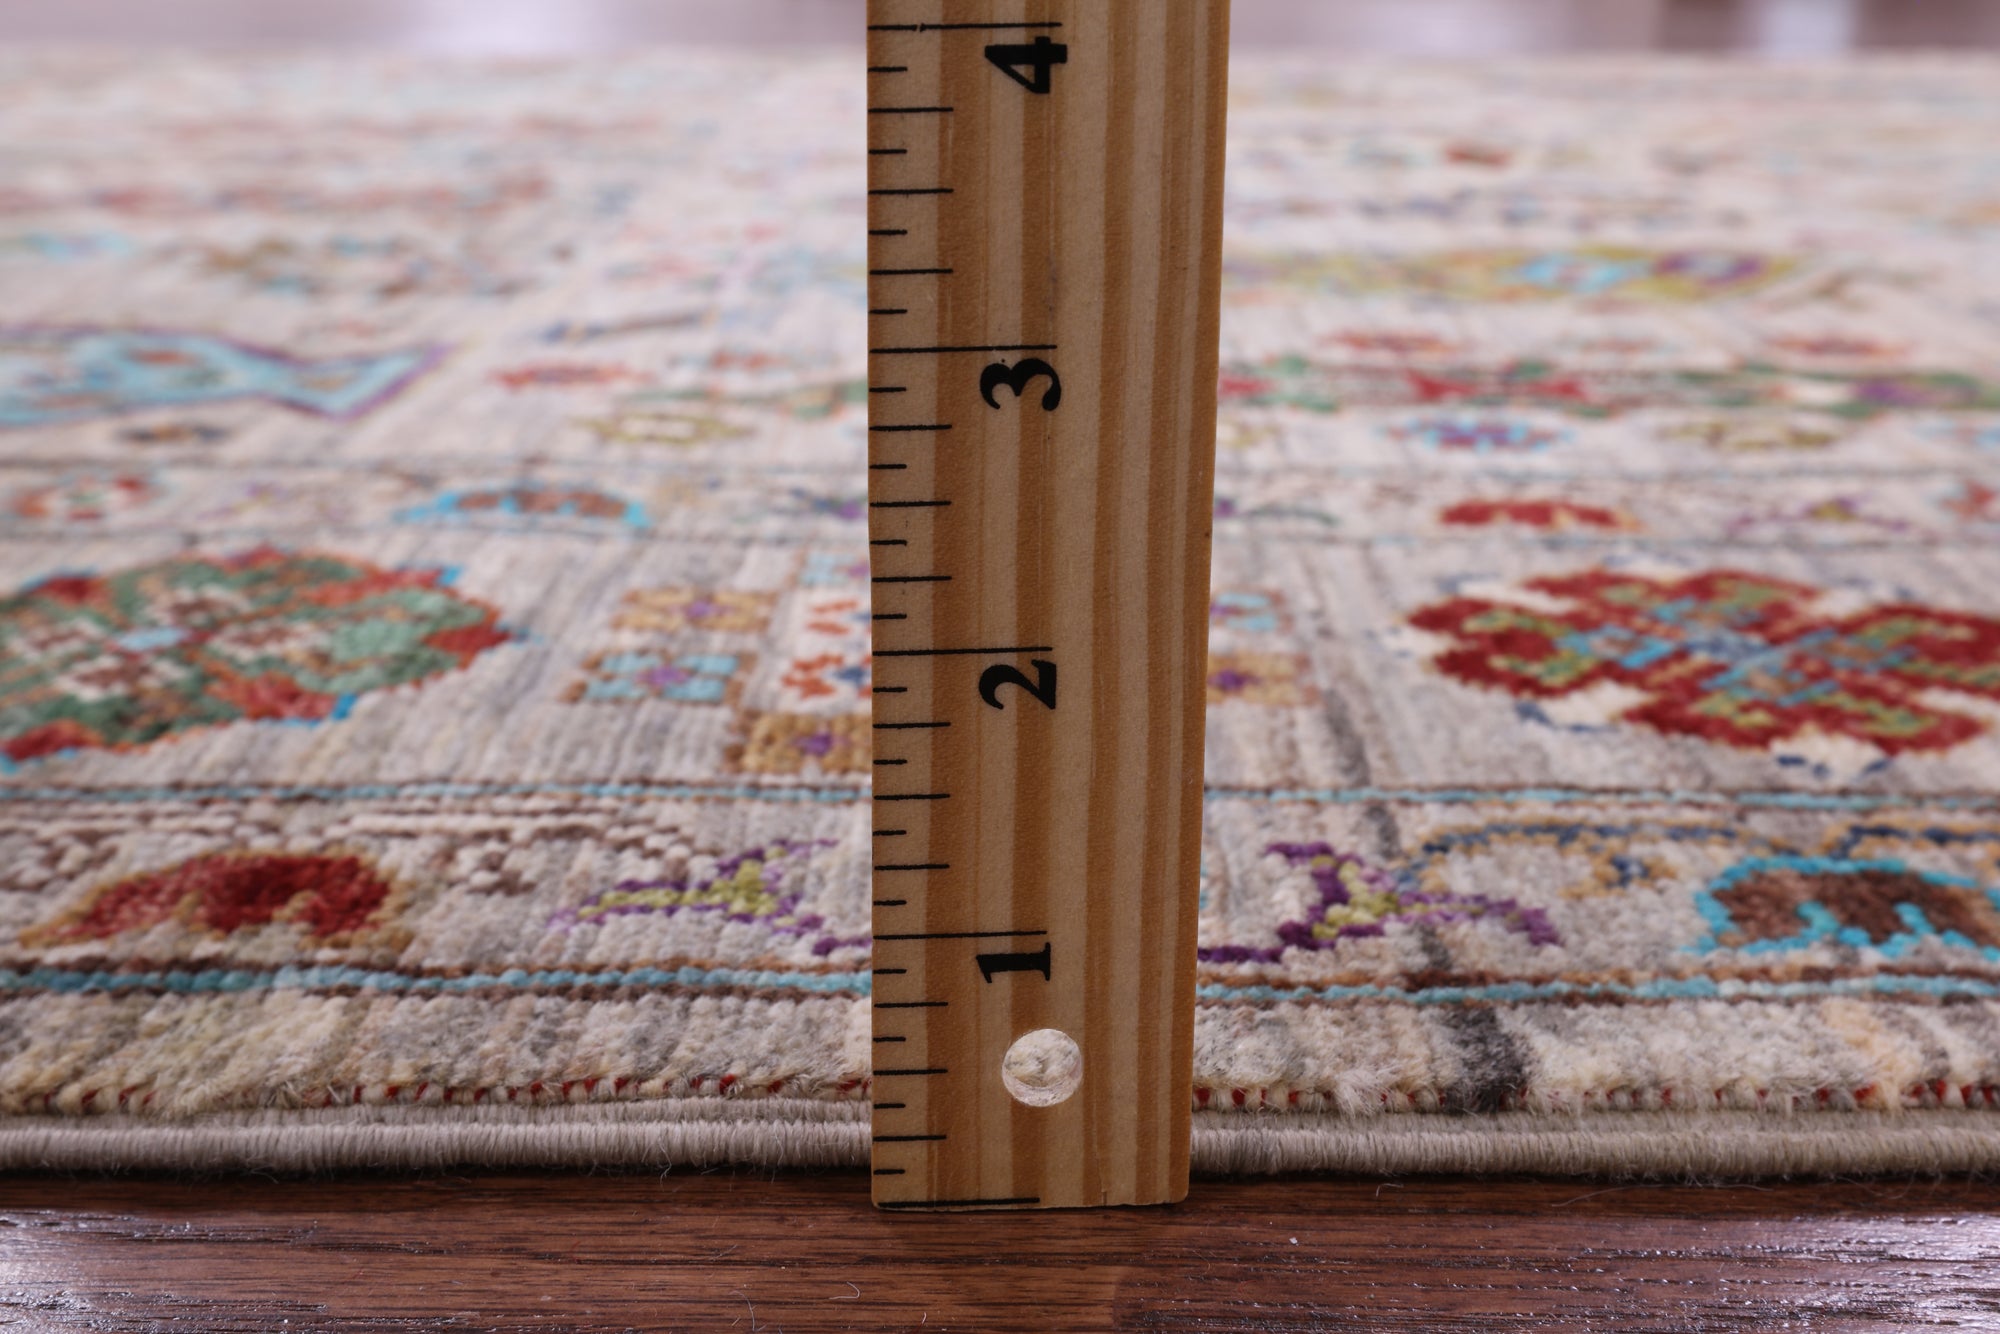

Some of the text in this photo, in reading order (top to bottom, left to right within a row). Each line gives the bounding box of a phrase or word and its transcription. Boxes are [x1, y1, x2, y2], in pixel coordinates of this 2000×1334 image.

[984, 35, 1068, 95] 4
[979, 357, 1062, 412] 3
[978, 658, 1057, 710] 2
[975, 942, 1051, 984] 1
